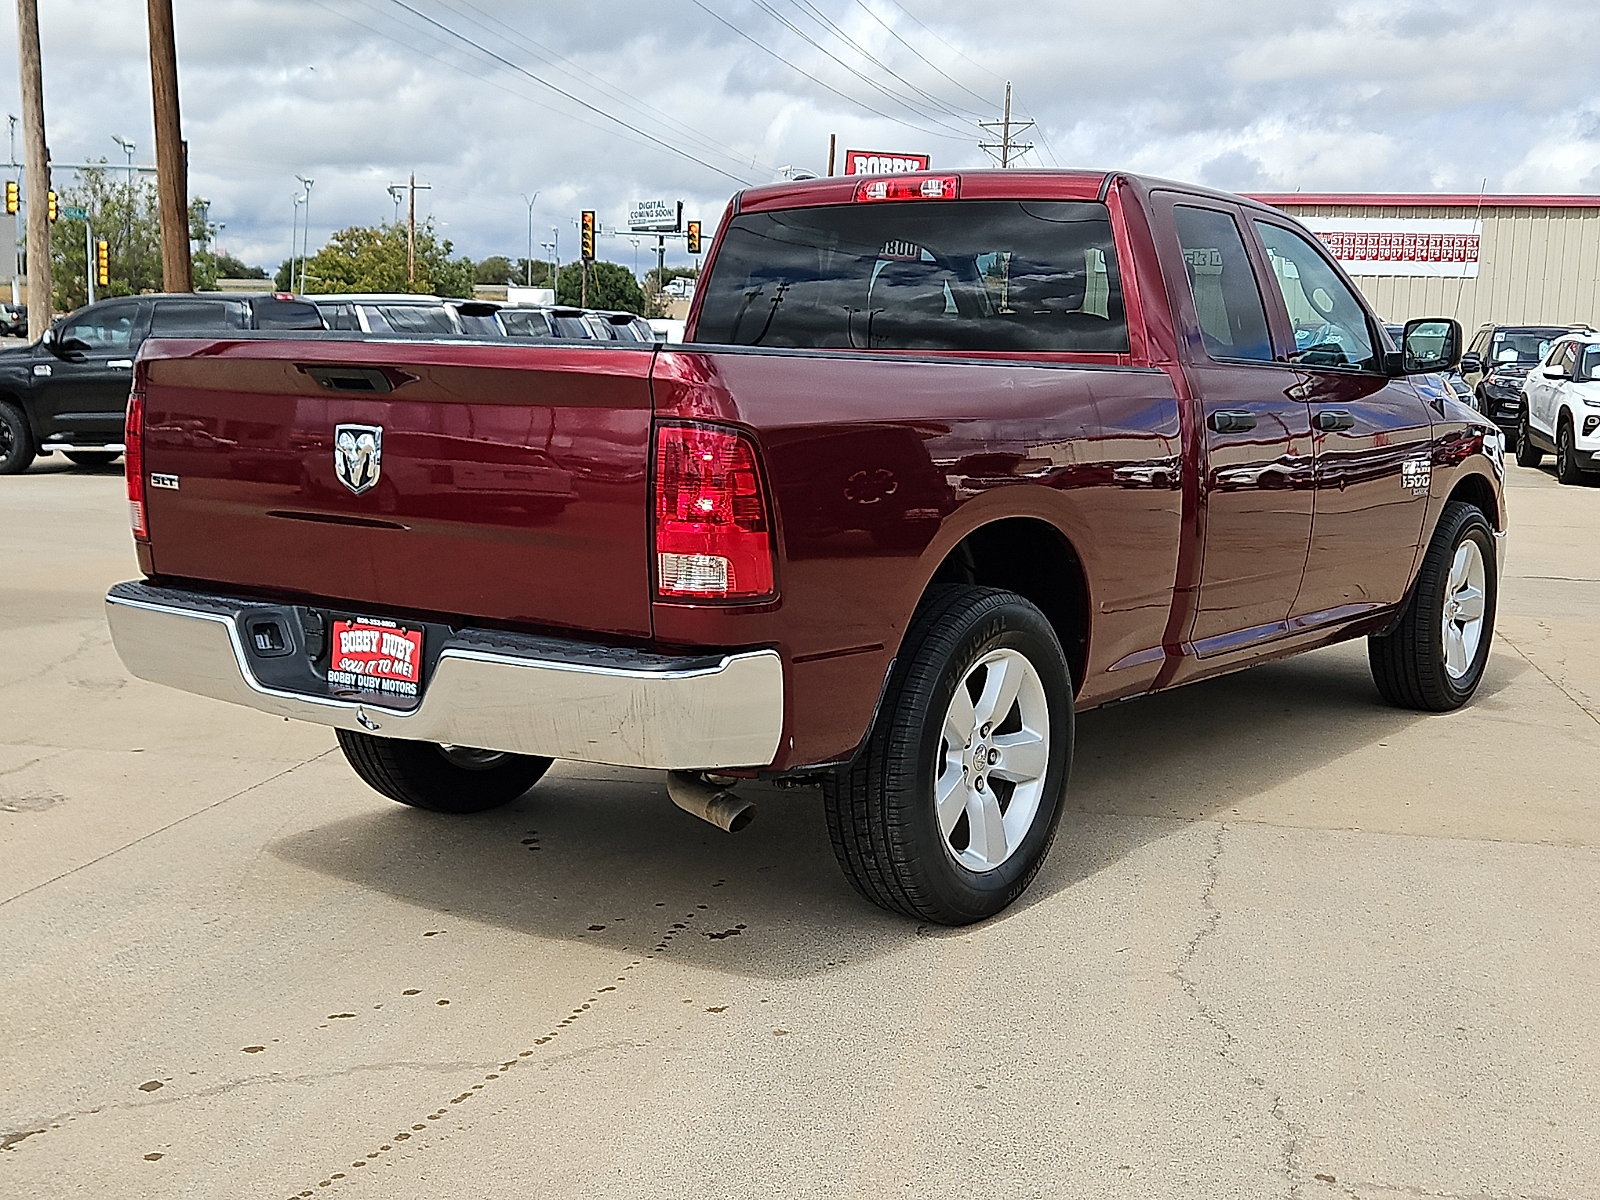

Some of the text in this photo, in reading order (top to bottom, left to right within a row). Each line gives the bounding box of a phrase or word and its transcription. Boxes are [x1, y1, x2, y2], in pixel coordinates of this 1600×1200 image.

[853, 156, 919, 175] BOBBY
[630, 208, 674, 219] COMING SOON!
[638, 200, 665, 210] DIGITAL
[151, 473, 179, 489] SLT
[1402, 475, 1431, 488] 1500
[339, 630, 415, 662] BOBBY DUBY
[338, 658, 413, 678] SOLD IT TO ME!
[327, 670, 417, 695] BOBBY DUBY MOTORS
